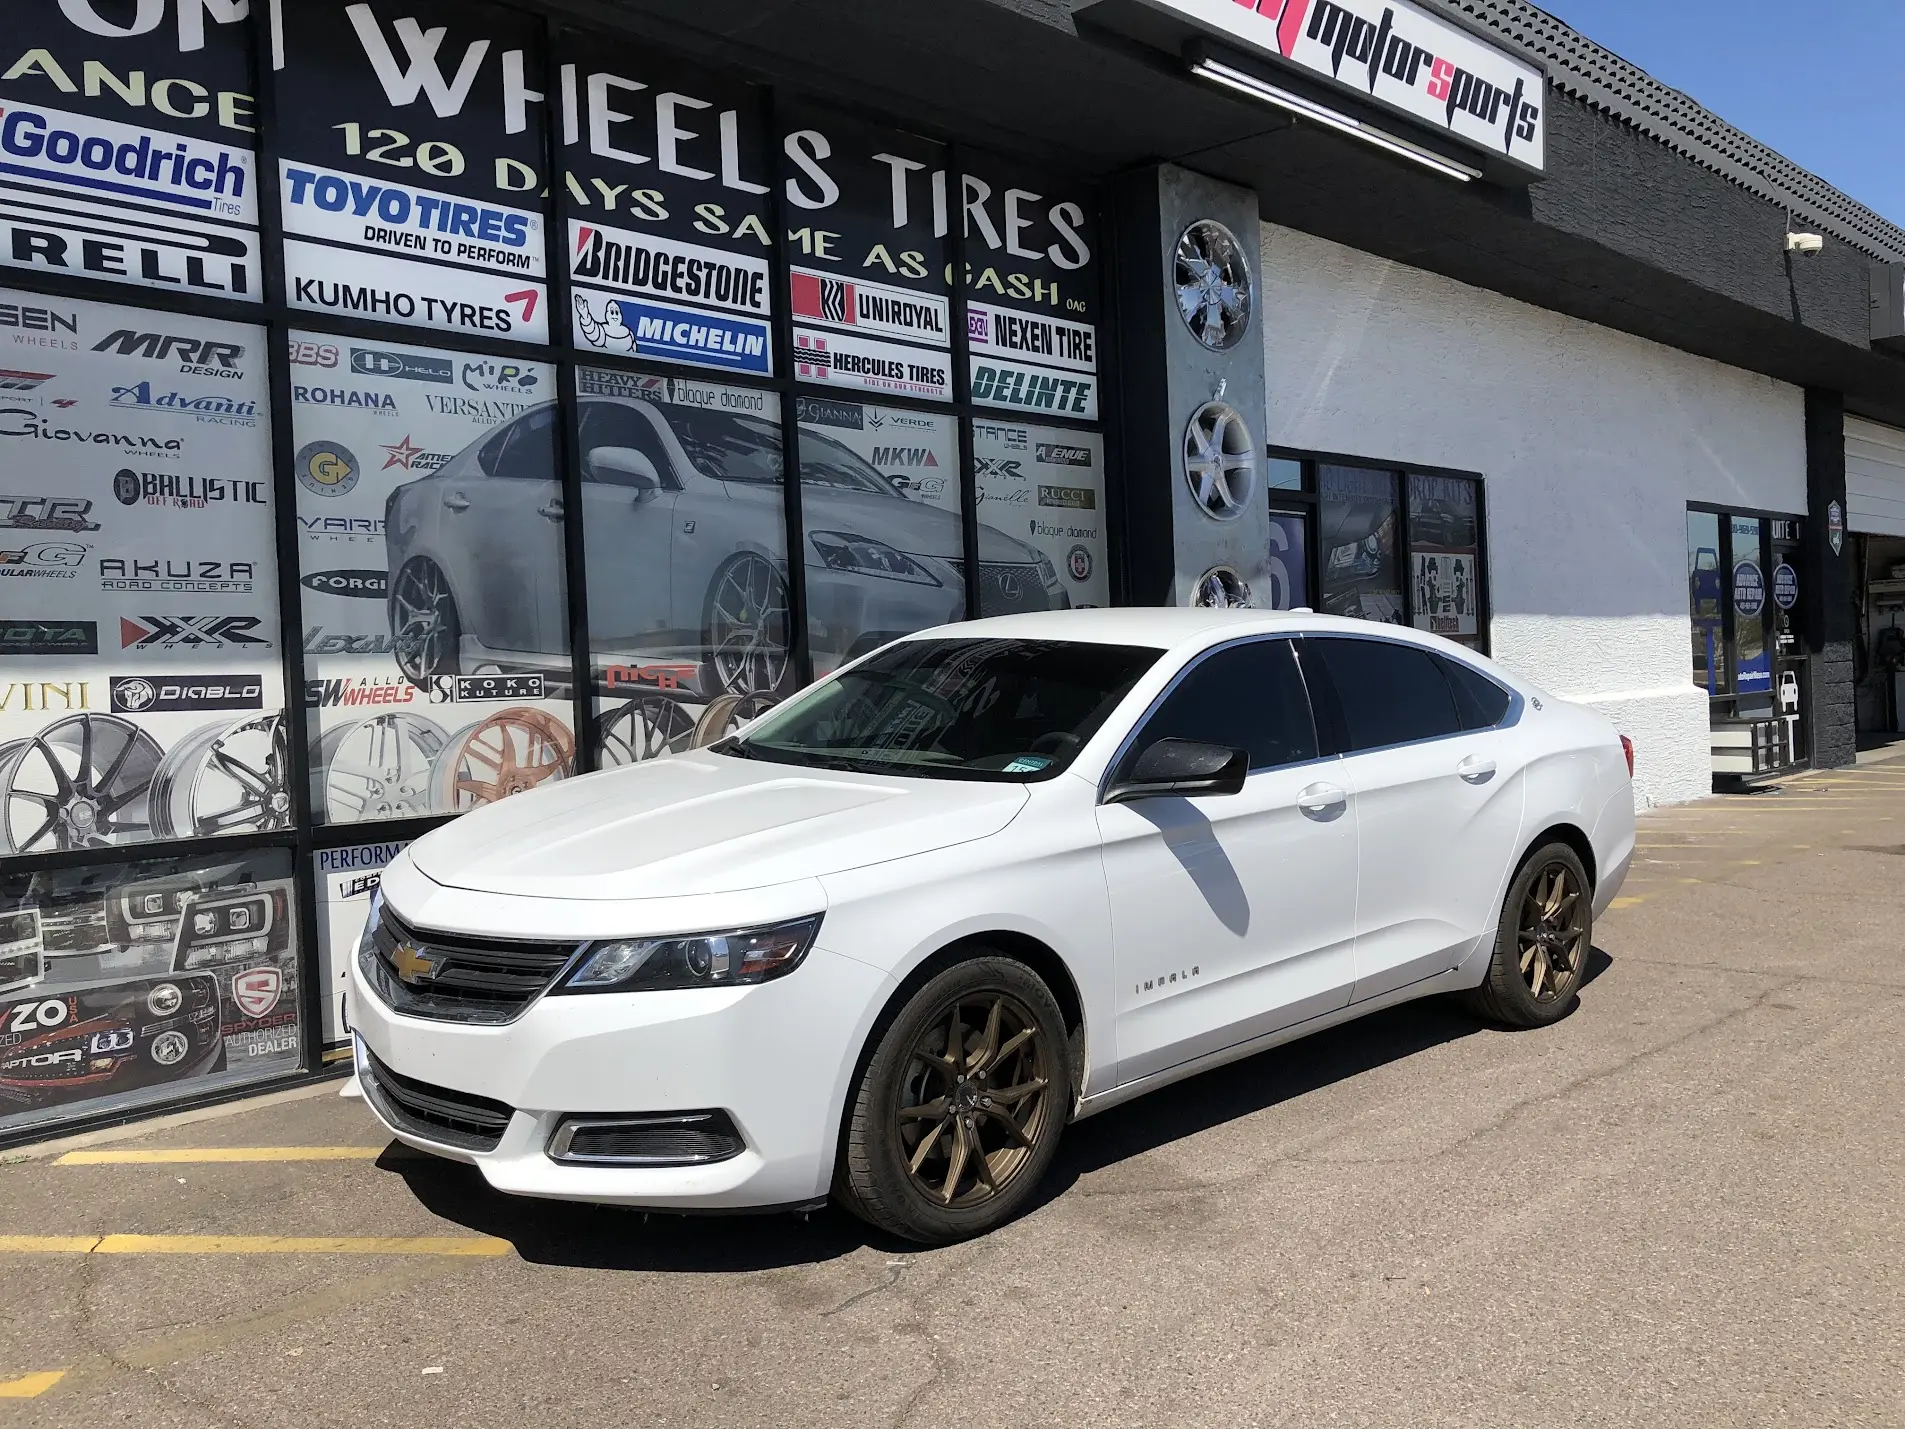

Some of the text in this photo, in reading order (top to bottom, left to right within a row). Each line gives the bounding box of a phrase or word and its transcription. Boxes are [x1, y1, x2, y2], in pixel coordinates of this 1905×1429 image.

[1306, 0, 1539, 155] motorsports
[345, 3, 840, 210] WHEELS
[872, 152, 1090, 270] TIRES
[1, 110, 246, 198] Goodrich
[213, 196, 242, 216] Tires
[285, 167, 529, 248] TOYO TIRES
[332, 122, 466, 177] 120
[495, 157, 670, 221] DAYS
[693, 204, 842, 261] SAME
[862, 244, 929, 279] AS
[944, 261, 1058, 306] CASH
[364, 225, 531, 270] DRIVEN TO PERFORM
[573, 227, 765, 309] BRIDGESTONE
[295, 276, 512, 333] KUMHO TYRES
[858, 292, 944, 334] UNIROYAL
[12, 333, 79, 351] WHEELS
[636, 315, 765, 357] MICHELIN
[994, 313, 1052, 357] NEXEN
[1055, 326, 1094, 363] TIRE
[90, 329, 246, 369] MRR
[179, 364, 244, 380] DESIGN
[405, 365, 451, 378] HELO
[580, 369, 642, 389] HEAVY
[833, 351, 946, 387] HERCULES TIRES
[0, 395, 33, 403] PORT
[110, 381, 256, 417] Advanti
[293, 385, 398, 410] ROHANA
[483, 383, 533, 395] WHEELS
[720, 388, 764, 411] diamond
[970, 365, 1092, 414] DELINTE
[196, 415, 256, 428] RACING
[808, 403, 862, 425] GIANNA
[890, 416, 935, 428] VERDE
[0, 408, 183, 451] Giovanna
[123, 449, 181, 460] WHEELS
[871, 446, 927, 467] MKW
[141, 472, 267, 505] BALLISTIC
[1040, 487, 1085, 501] RUCCI
[147, 495, 206, 509] OFF ROAD
[99, 558, 254, 579] AKUZA
[101, 580, 254, 592] ROAD CONCEPTS
[311, 575, 386, 591] FORGI
[136, 643, 274, 651] WHEELS
[460, 678, 541, 689] KOKO
[460, 687, 541, 698] KUTURE
[343, 685, 416, 707] WHEELS
[1135, 965, 1200, 995] IMPALA
[68, 996, 79, 1024] USA
[221, 1013, 297, 1035] SPYDER
[225, 1023, 297, 1047] AUTHORIZED
[248, 1036, 297, 1057] DEALER
